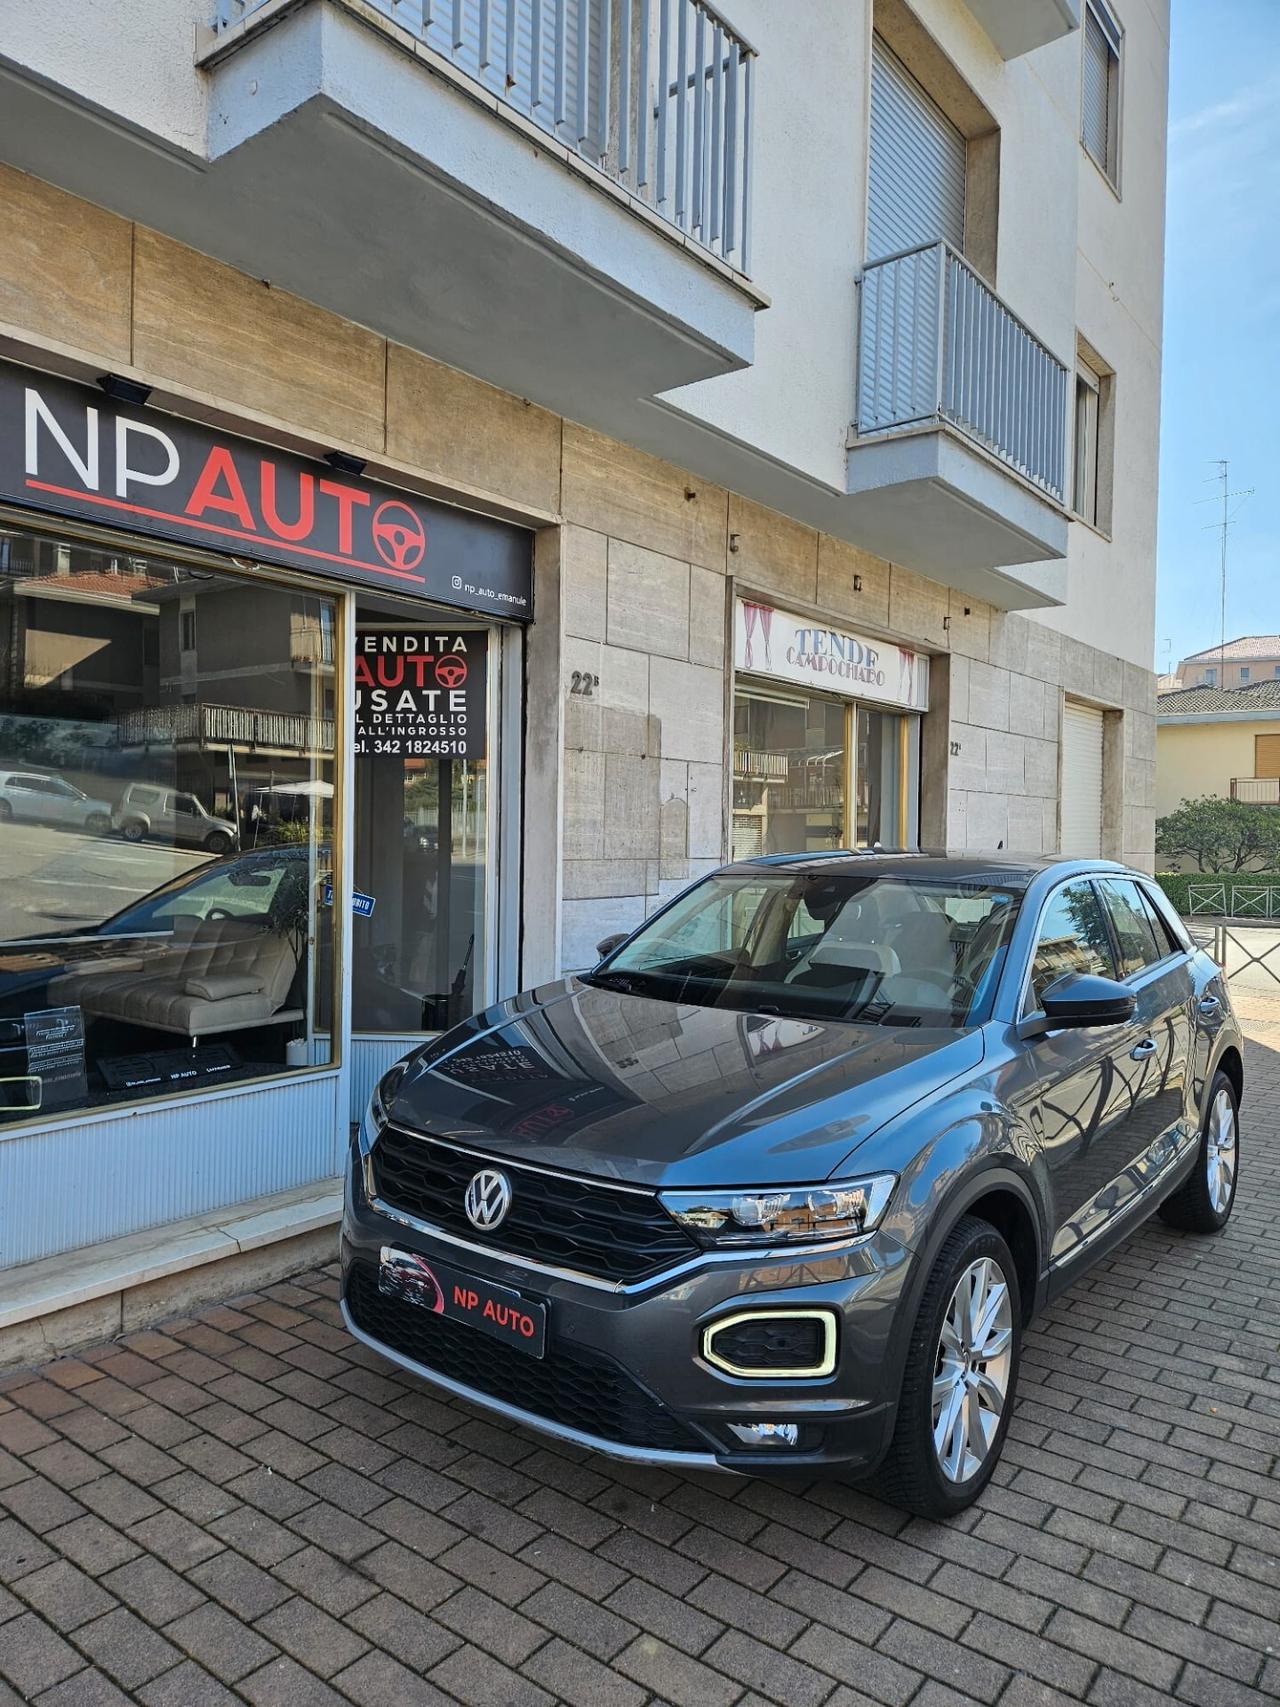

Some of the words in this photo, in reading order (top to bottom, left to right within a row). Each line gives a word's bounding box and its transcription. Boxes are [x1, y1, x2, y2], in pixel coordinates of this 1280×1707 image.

[355, 636, 467, 652] ENDITA
[373, 714, 467, 724] DETTAGLIO
[358, 726, 467, 735] ALL'INGROSSO
[354, 740, 369, 753] el.
[374, 740, 400, 753] 342
[406, 740, 466, 754] 1824510
[454, 1286, 479, 1310] NP
[483, 1299, 534, 1337] AUTO
